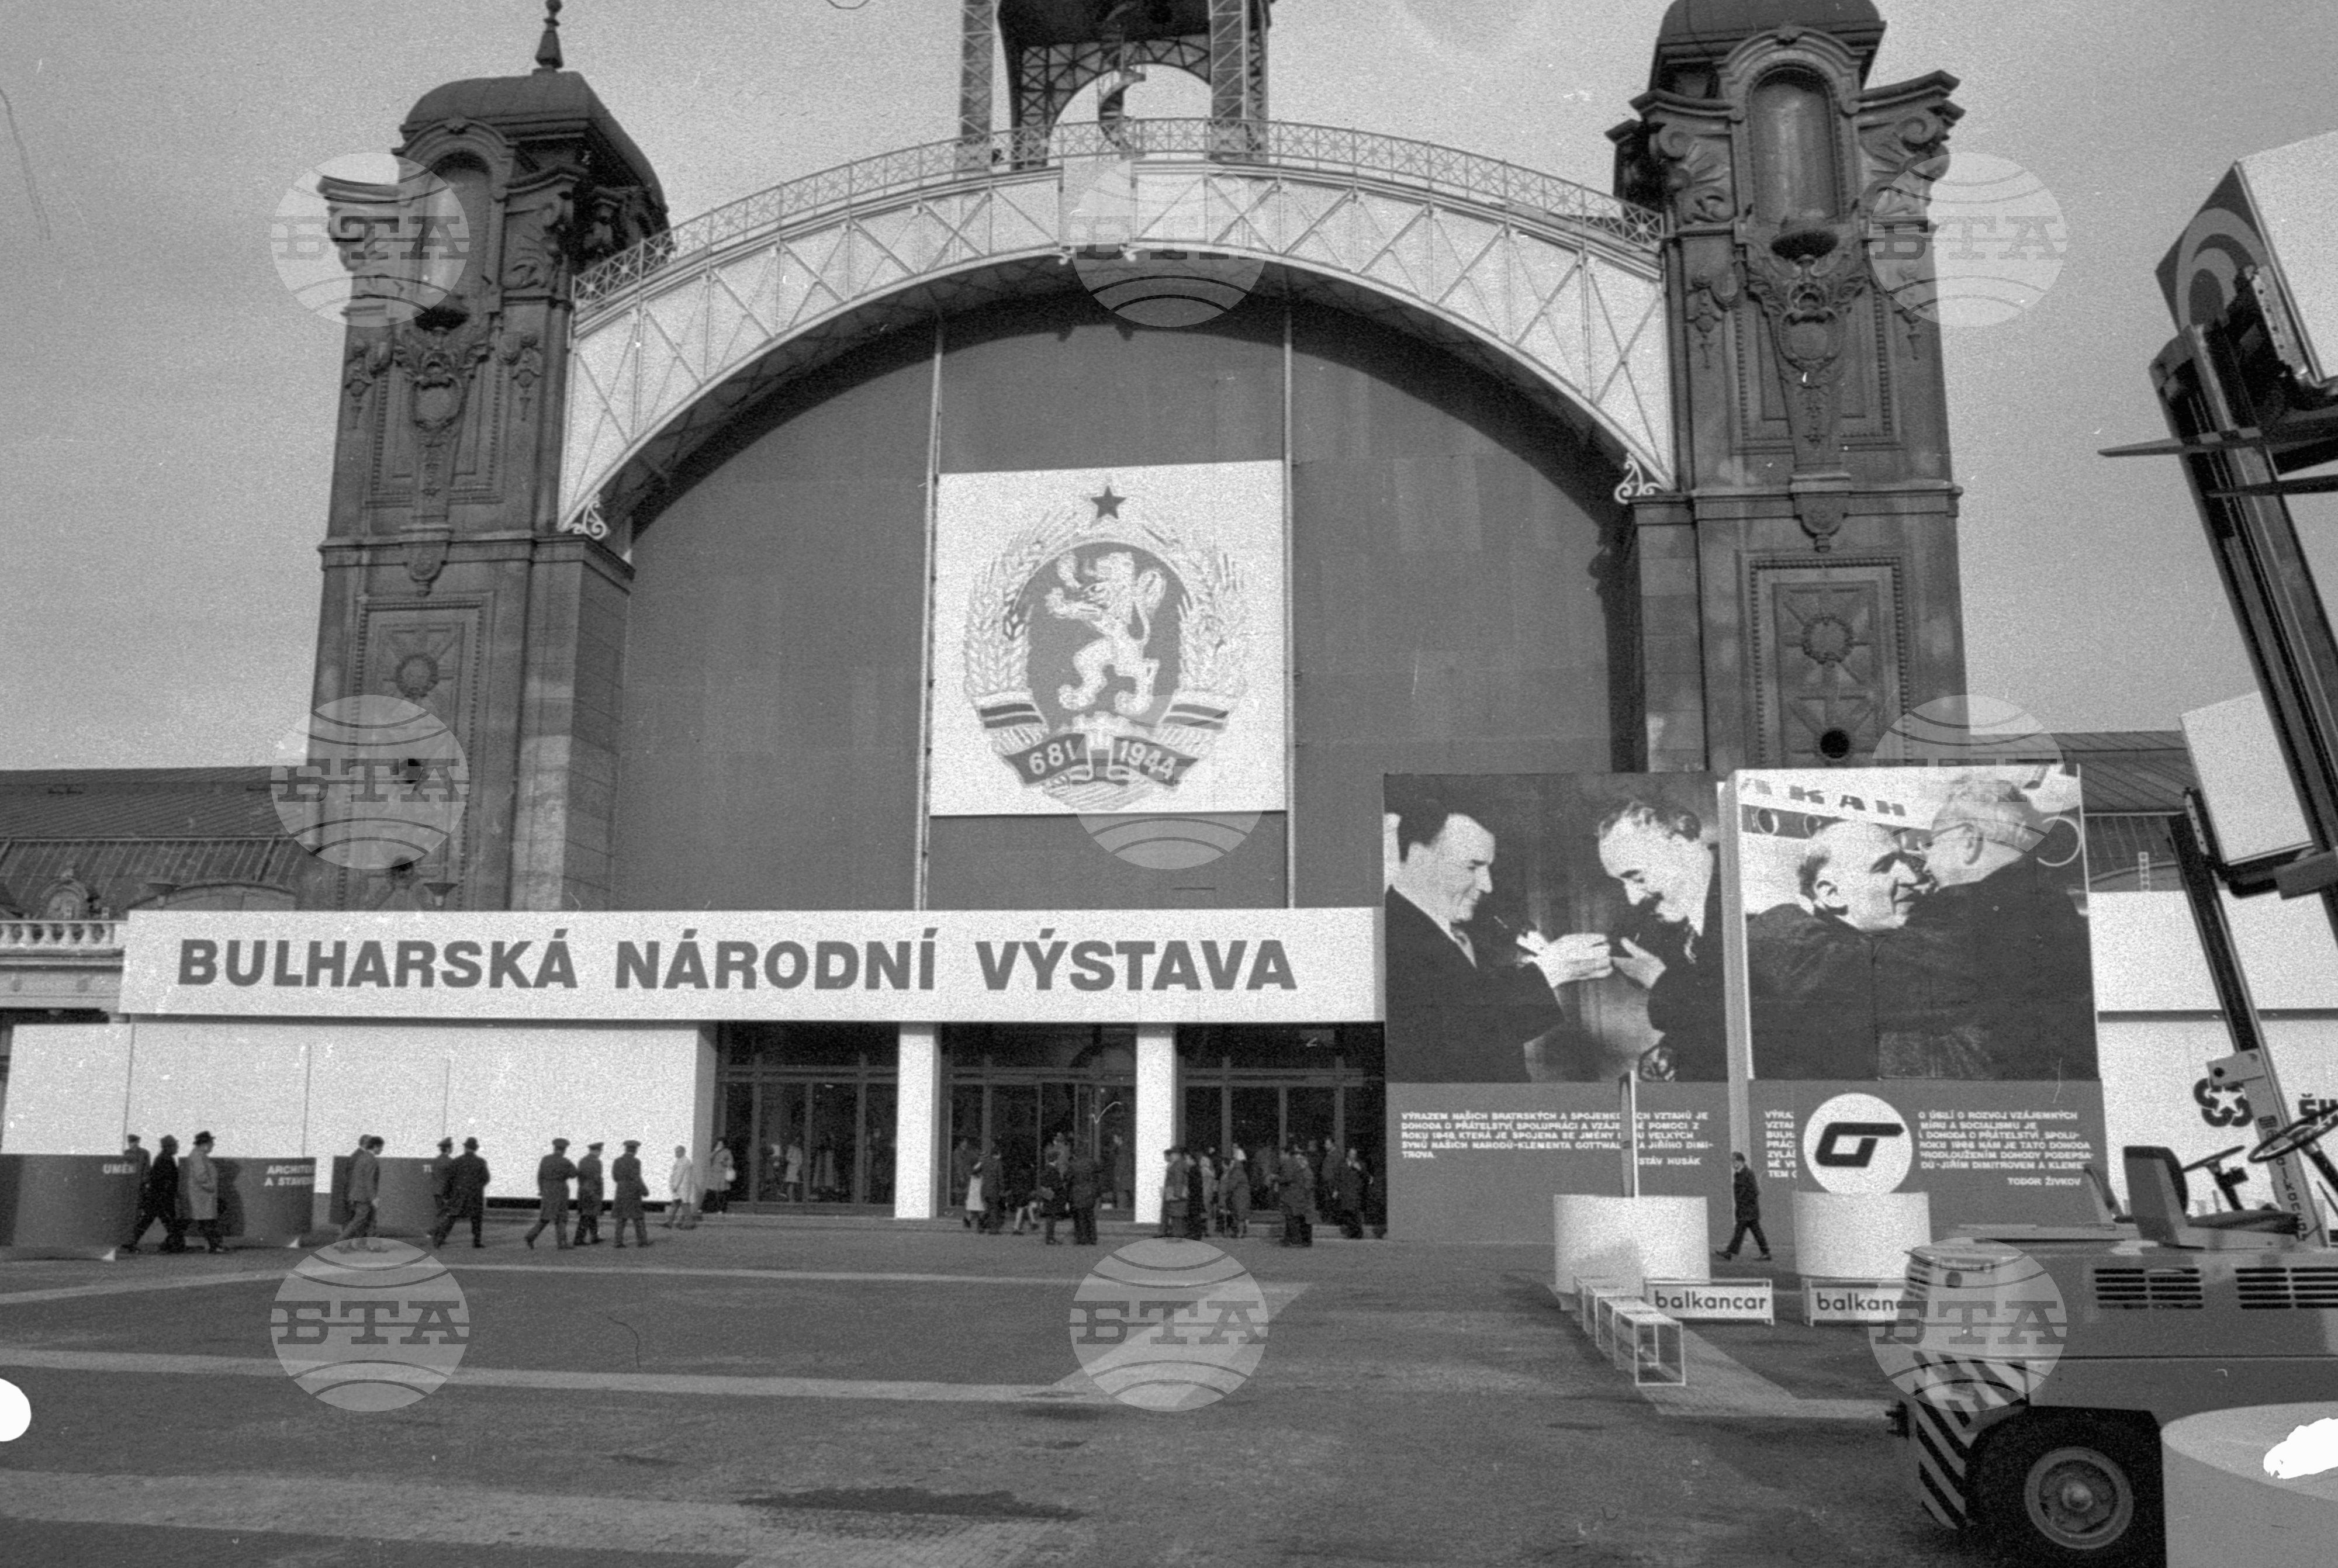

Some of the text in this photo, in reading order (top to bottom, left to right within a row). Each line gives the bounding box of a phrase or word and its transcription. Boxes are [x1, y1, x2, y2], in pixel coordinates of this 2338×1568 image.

[1029, 740, 1075, 776] 681
[1120, 740, 1177, 780] 1944
[178, 927, 1297, 991] BULHARSKÁ NÁRODNÍ VÝSTAVA
[1452, 1110, 1488, 1120] NAŠICH
[1492, 1112, 1557, 1120] BRATRSKÝCH
[1517, 1122, 1578, 1130] SPOLUPRÁCI
[1592, 1121, 1645, 1130] VZÁJEÉ
[1960, 1122, 2019, 1130] SOCIALISMU
[1459, 1131, 1491, 1139] KTERÁ
[1648, 1131, 1694, 1140] VELKÝCH
[1431, 1140, 1468, 1148] NAŠICH
[1638, 1156, 1700, 1165] STÁV HUSÁK
[264, 1176, 274, 1186] A
[2045, 1176, 2081, 1186] ŽIVKOV
[1655, 1290, 1766, 1310] balkancar
